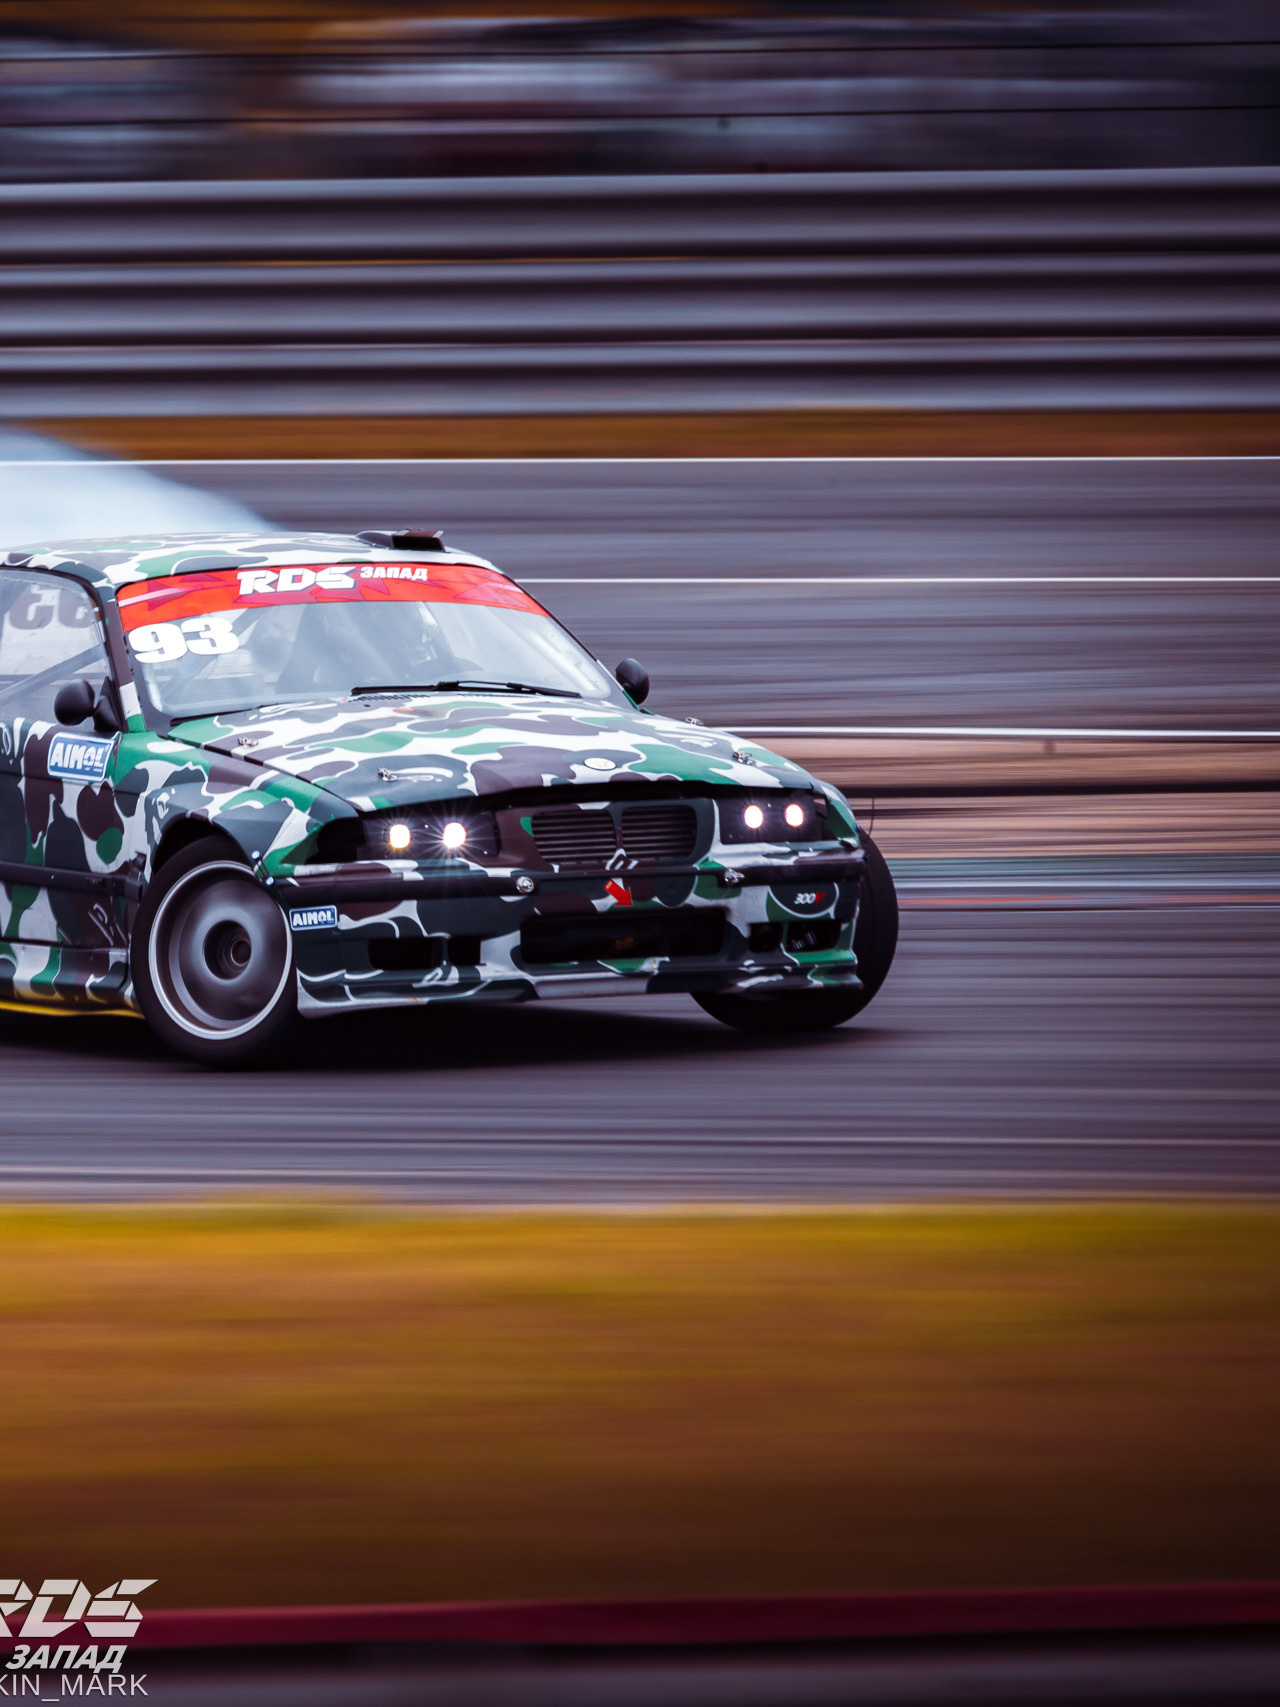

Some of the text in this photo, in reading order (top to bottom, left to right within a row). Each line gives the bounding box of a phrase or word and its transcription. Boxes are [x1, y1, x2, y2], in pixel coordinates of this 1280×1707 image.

[236, 566, 356, 595] RDS
[360, 566, 428, 581] ЗАПАД
[128, 617, 239, 664] 93
[50, 742, 105, 773] AIMOL
[793, 891, 826, 905] 300V
[292, 910, 334, 927] AIMOL
